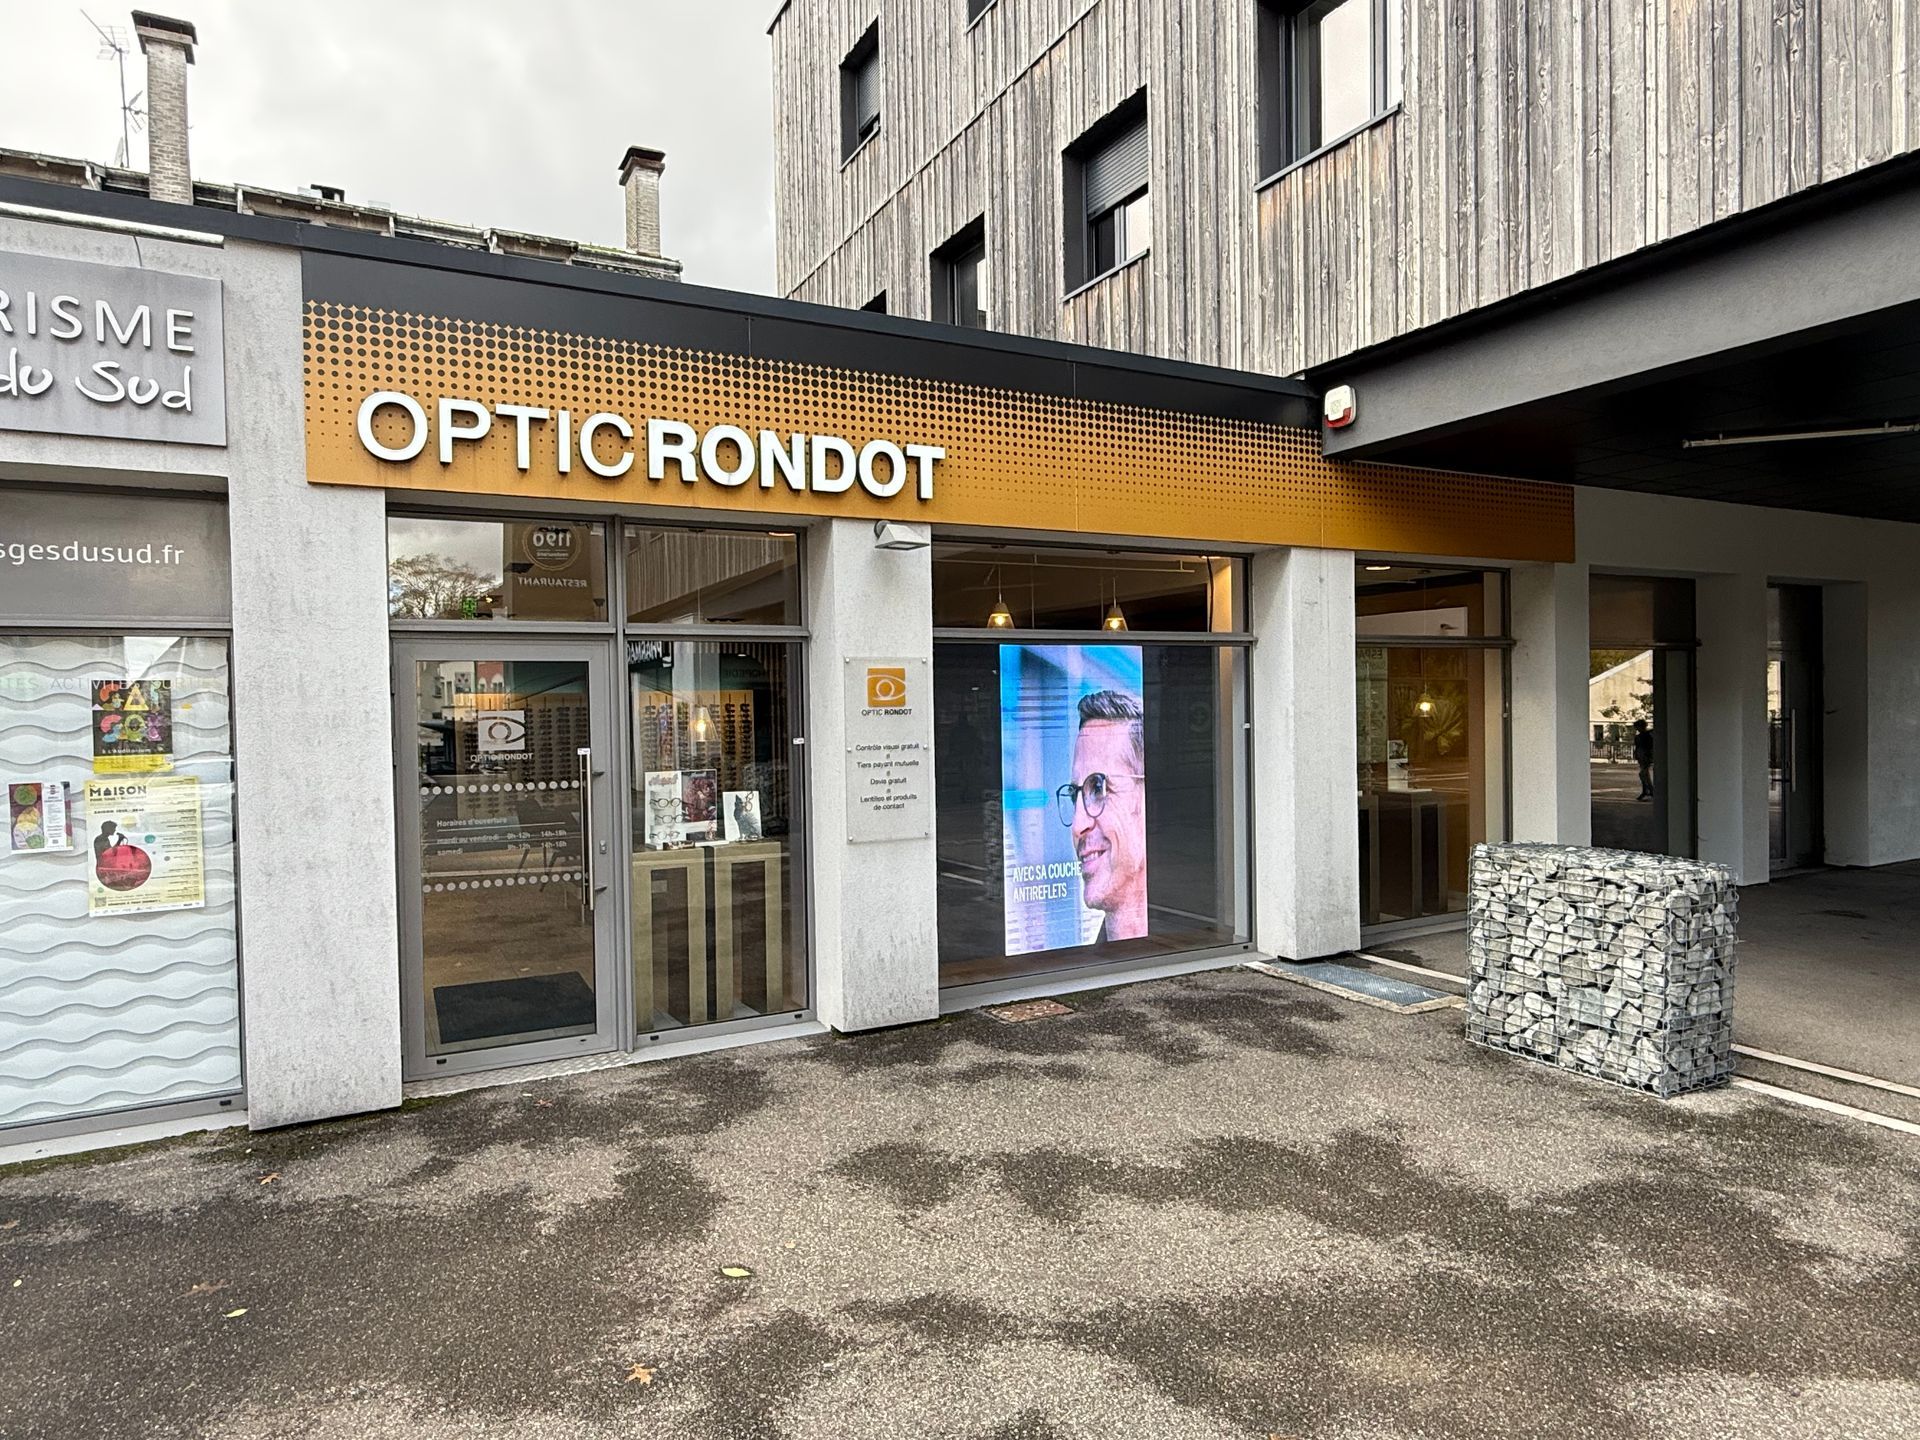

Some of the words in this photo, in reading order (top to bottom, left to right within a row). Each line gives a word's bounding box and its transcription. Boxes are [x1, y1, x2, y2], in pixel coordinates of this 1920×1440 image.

[75, 361, 192, 412] Sud
[884, 708, 912, 716] RONDOT
[901, 743, 919, 751] gratuit
[888, 777, 907, 785] gratuit
[1013, 865, 1035, 883] AVEC
[1036, 863, 1048, 881] SA
[1048, 860, 1083, 879] COUCHE
[1013, 882, 1068, 902] ANTIREFLETS
